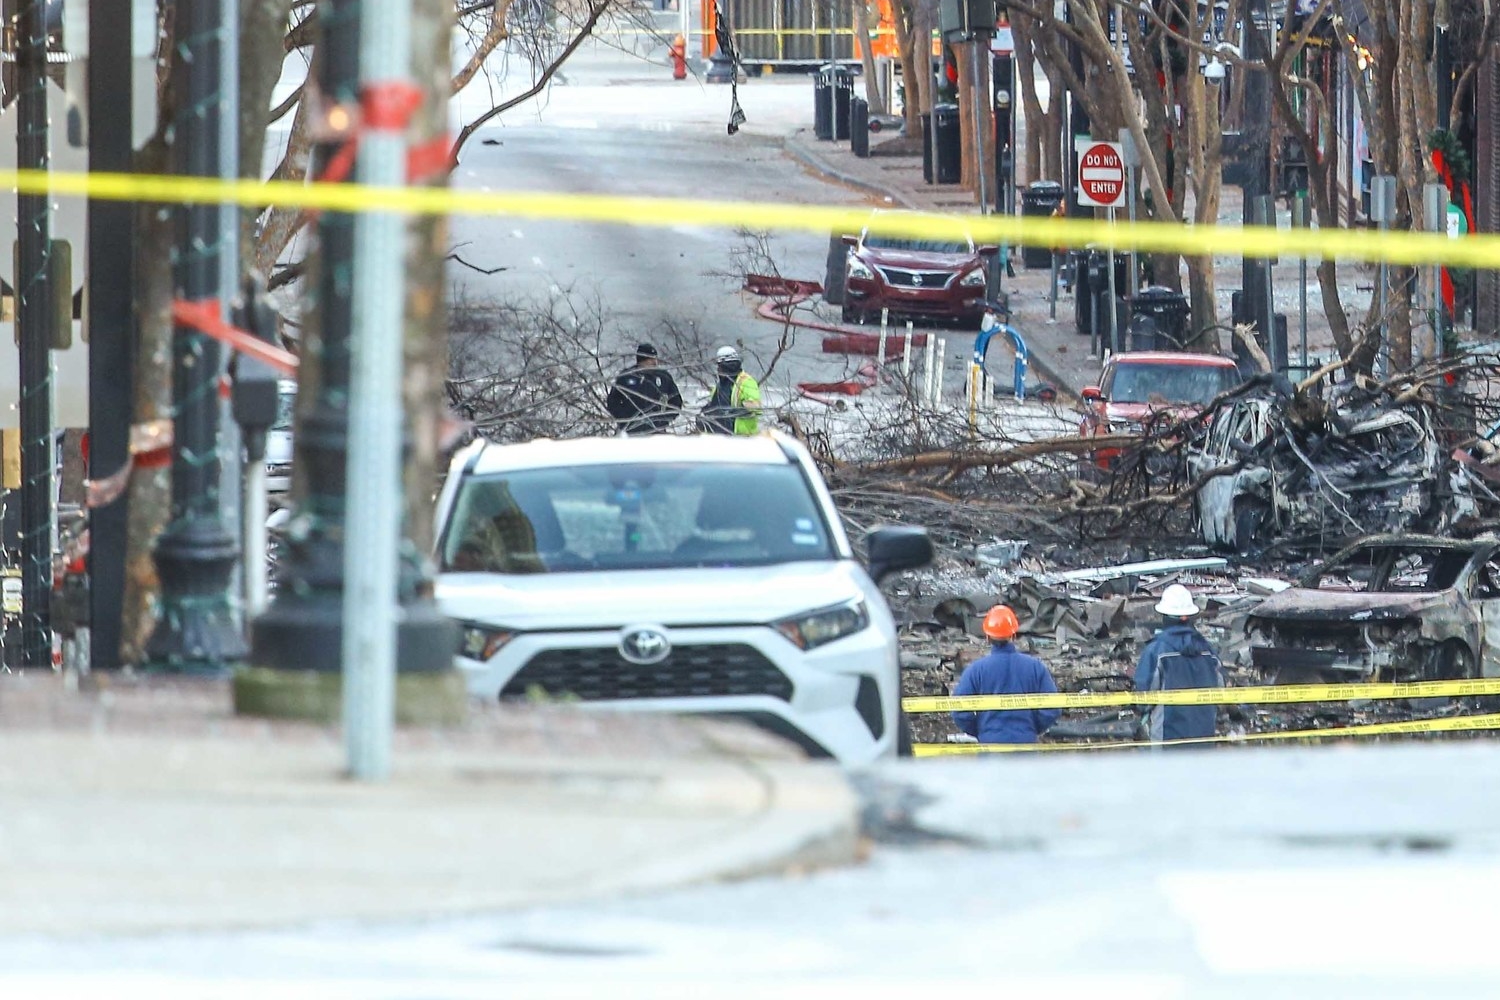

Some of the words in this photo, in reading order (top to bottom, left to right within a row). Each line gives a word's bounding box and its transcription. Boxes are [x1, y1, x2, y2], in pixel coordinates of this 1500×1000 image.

[1086, 154, 1100, 166] DO
[1103, 154, 1118, 166] NOT
[1090, 182, 1117, 194] ENTER
